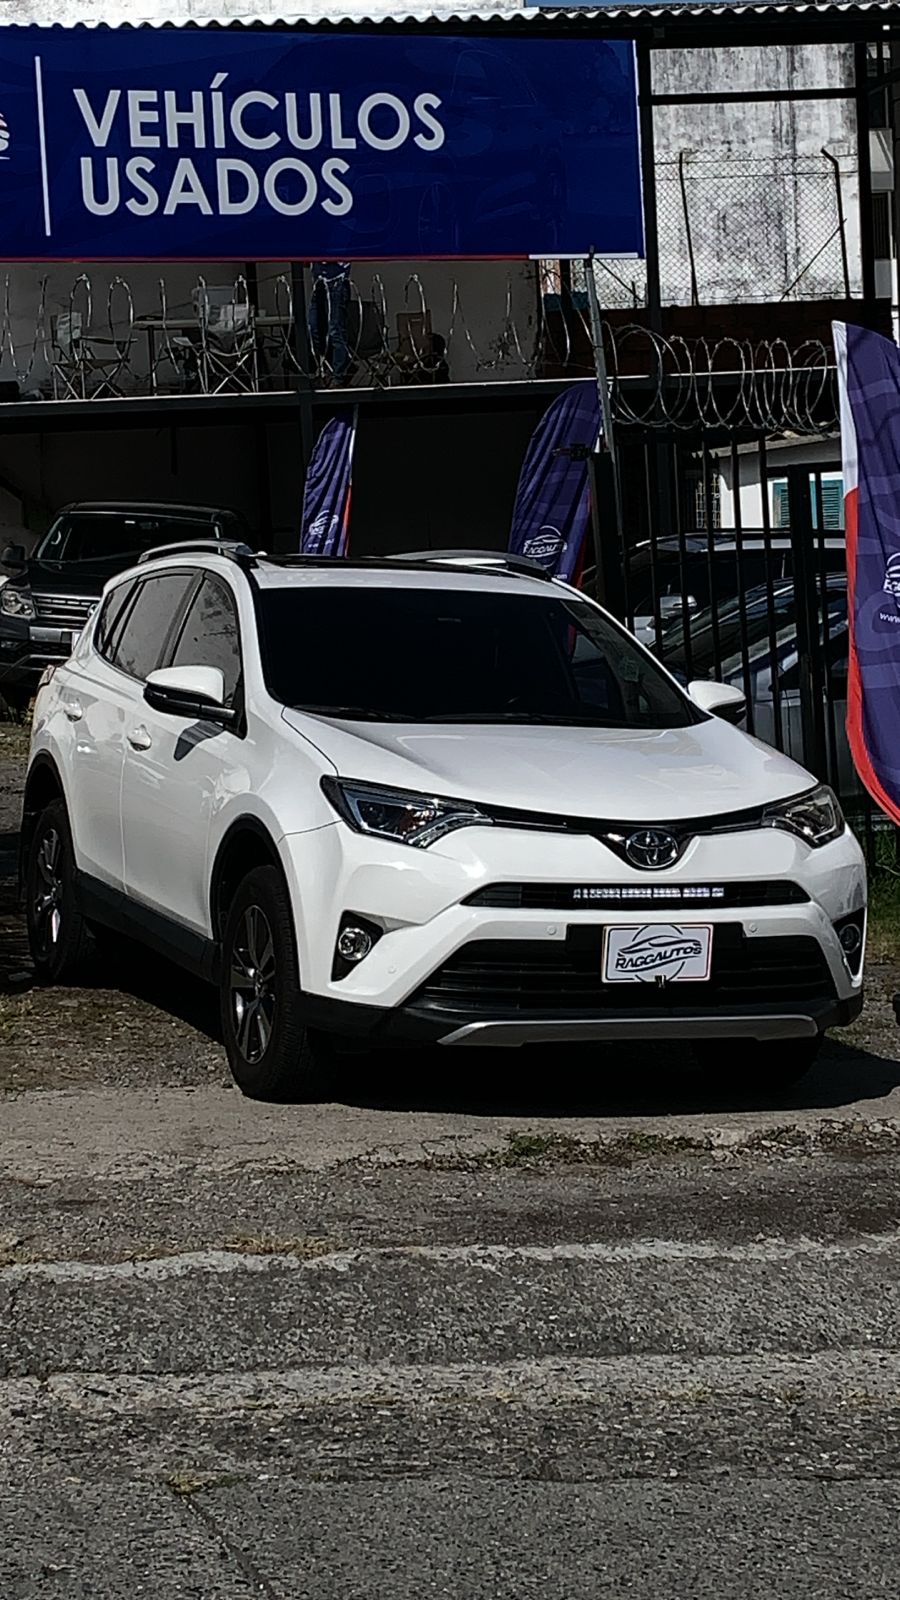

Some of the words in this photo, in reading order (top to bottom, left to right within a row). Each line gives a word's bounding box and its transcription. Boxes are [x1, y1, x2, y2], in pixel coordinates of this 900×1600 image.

[73, 72, 446, 152] VEHÍCULOS
[79, 155, 353, 217] USADOS
[615, 946, 702, 969] RAGGAUTOS
